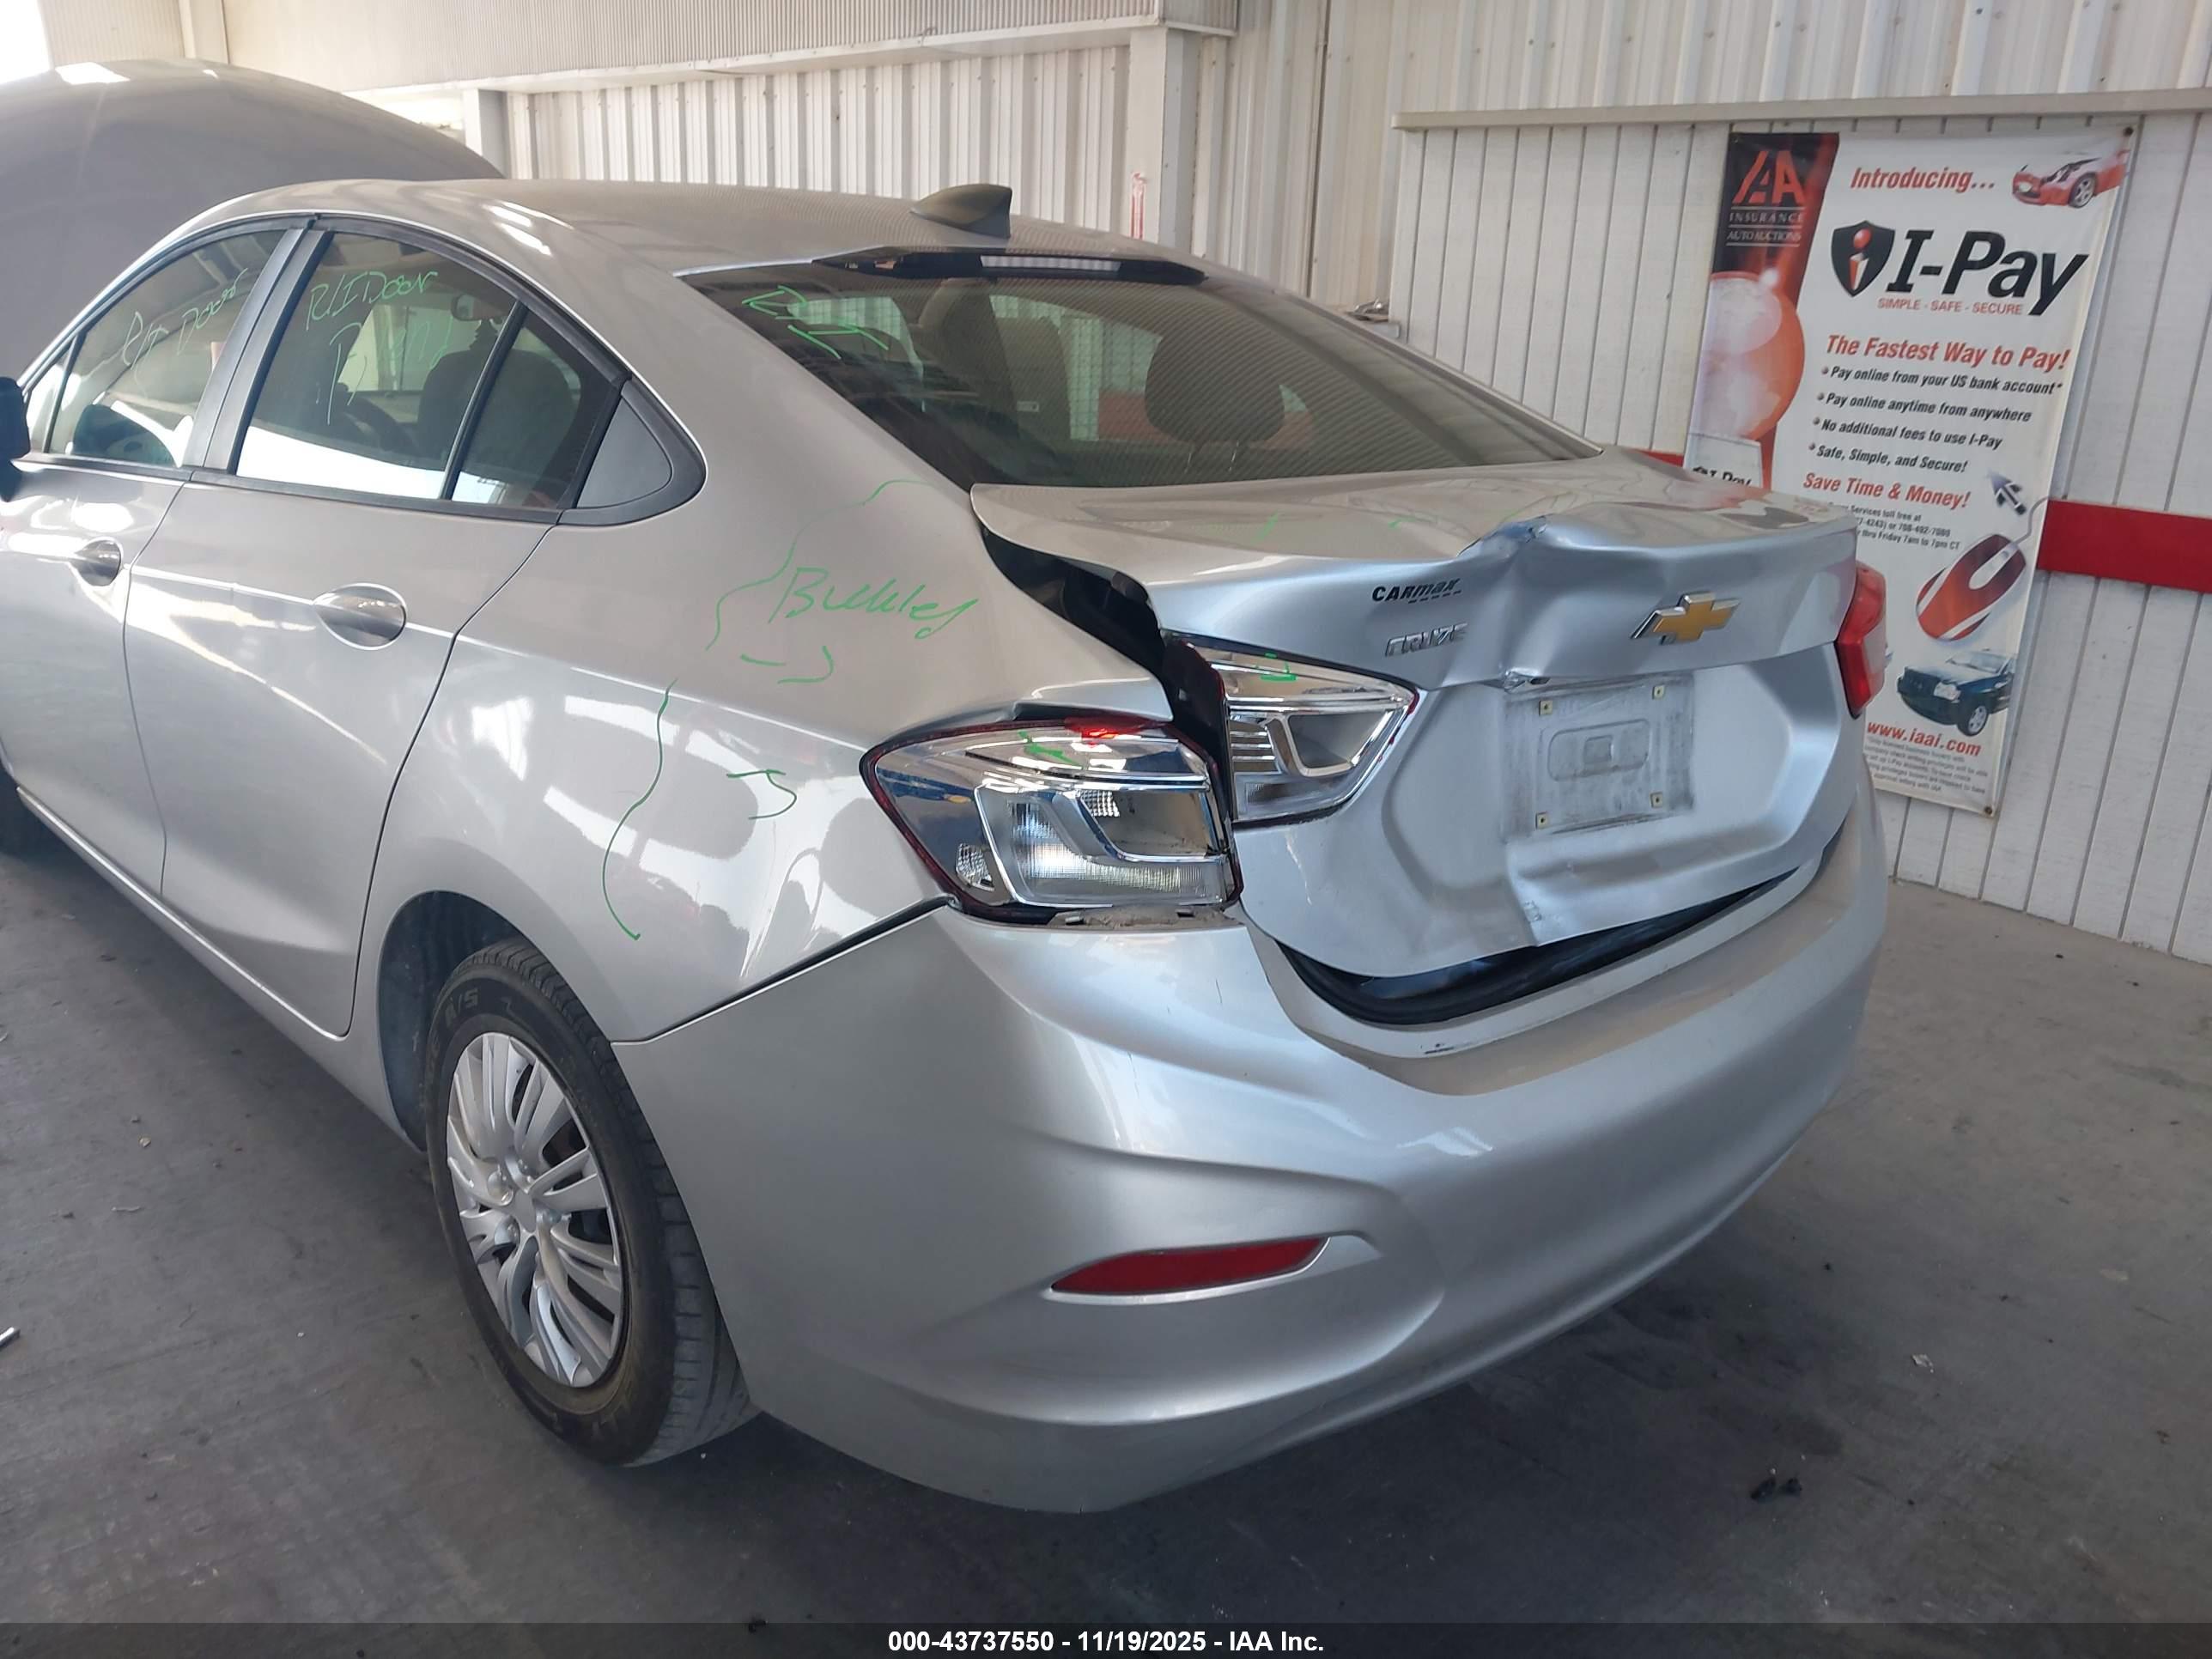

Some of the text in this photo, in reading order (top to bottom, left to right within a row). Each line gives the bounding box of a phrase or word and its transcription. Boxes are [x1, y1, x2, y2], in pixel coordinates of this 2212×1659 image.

[1850, 166, 1995, 193] Introducing...
[1729, 212, 1804, 223] INSURANCE
[1726, 230, 1753, 241] AUTO
[1885, 229, 2089, 316] I-Pay
[1877, 297, 1920, 312] SIMPLE
[1930, 301, 1962, 313] SAFE
[1972, 302, 2025, 315] SECURE
[1826, 334, 2071, 373] The Fastest Way to Pay!
[1830, 365, 1851, 381] Pay
[1854, 368, 1890, 382] online
[1891, 369, 1918, 385] from
[1920, 374, 1949, 388] your
[1950, 374, 1967, 388] US
[1969, 377, 2000, 392] bank
[1826, 392, 2033, 422] Pay online anytime from anywhere
[1820, 418, 2003, 451] No additional fees to use I-Pay
[1816, 444, 1969, 473] Safe, Simple, and Secure!
[1802, 471, 1972, 510] Save Time & Money!
[1850, 504, 1881, 517] Services
[1882, 509, 1895, 519] toll
[1896, 511, 1911, 521] free
[1862, 529, 1877, 538] thru
[1877, 531, 1902, 544] Friday
[1902, 534, 1920, 545] 7am
[1921, 538, 1929, 546] to
[1930, 539, 1948, 550] 7pm
[1948, 541, 1961, 550] CT
[1867, 721, 1982, 757] www.iaai.com
